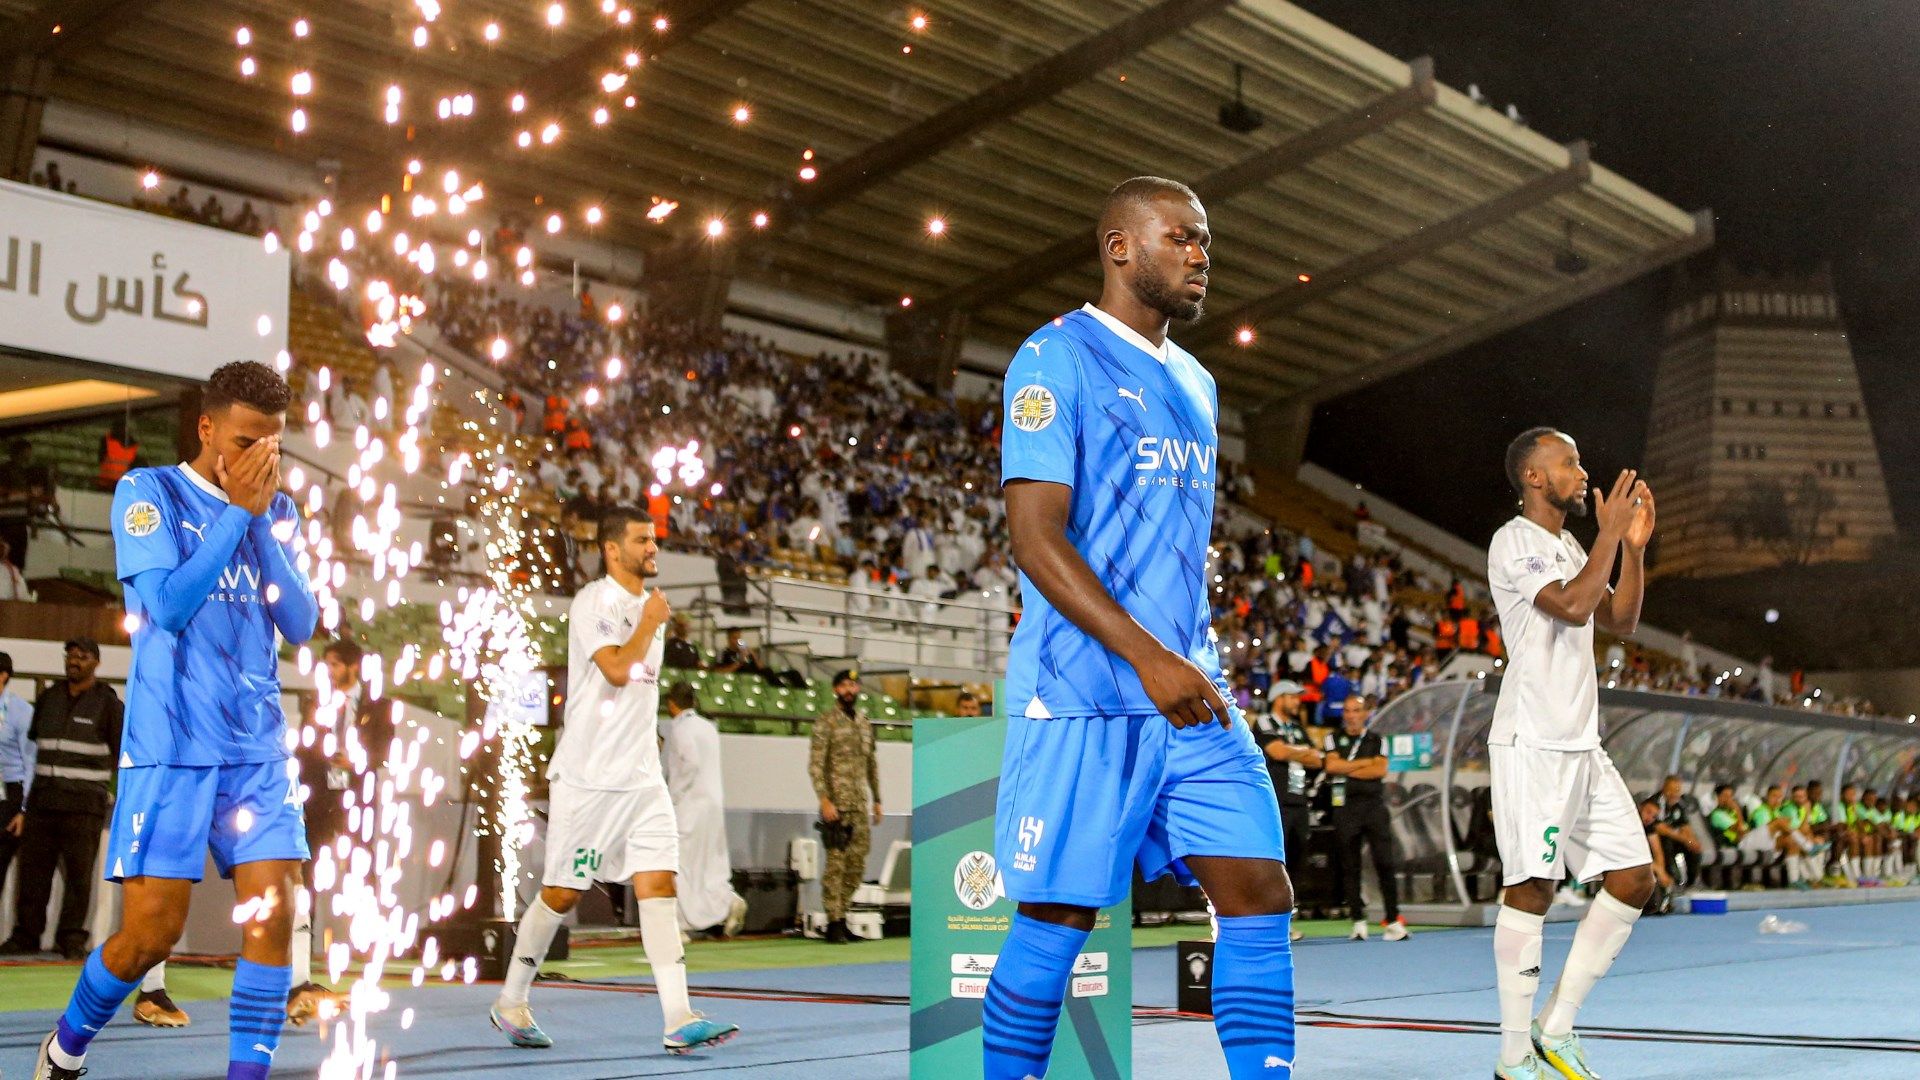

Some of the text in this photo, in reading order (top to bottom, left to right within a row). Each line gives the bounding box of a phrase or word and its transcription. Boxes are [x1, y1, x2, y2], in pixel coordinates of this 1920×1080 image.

[65, 252, 209, 329] كأس
[1191, 480, 1216, 492] GRO
[1542, 826, 1560, 863] 5
[1077, 982, 1103, 993] Emirates
